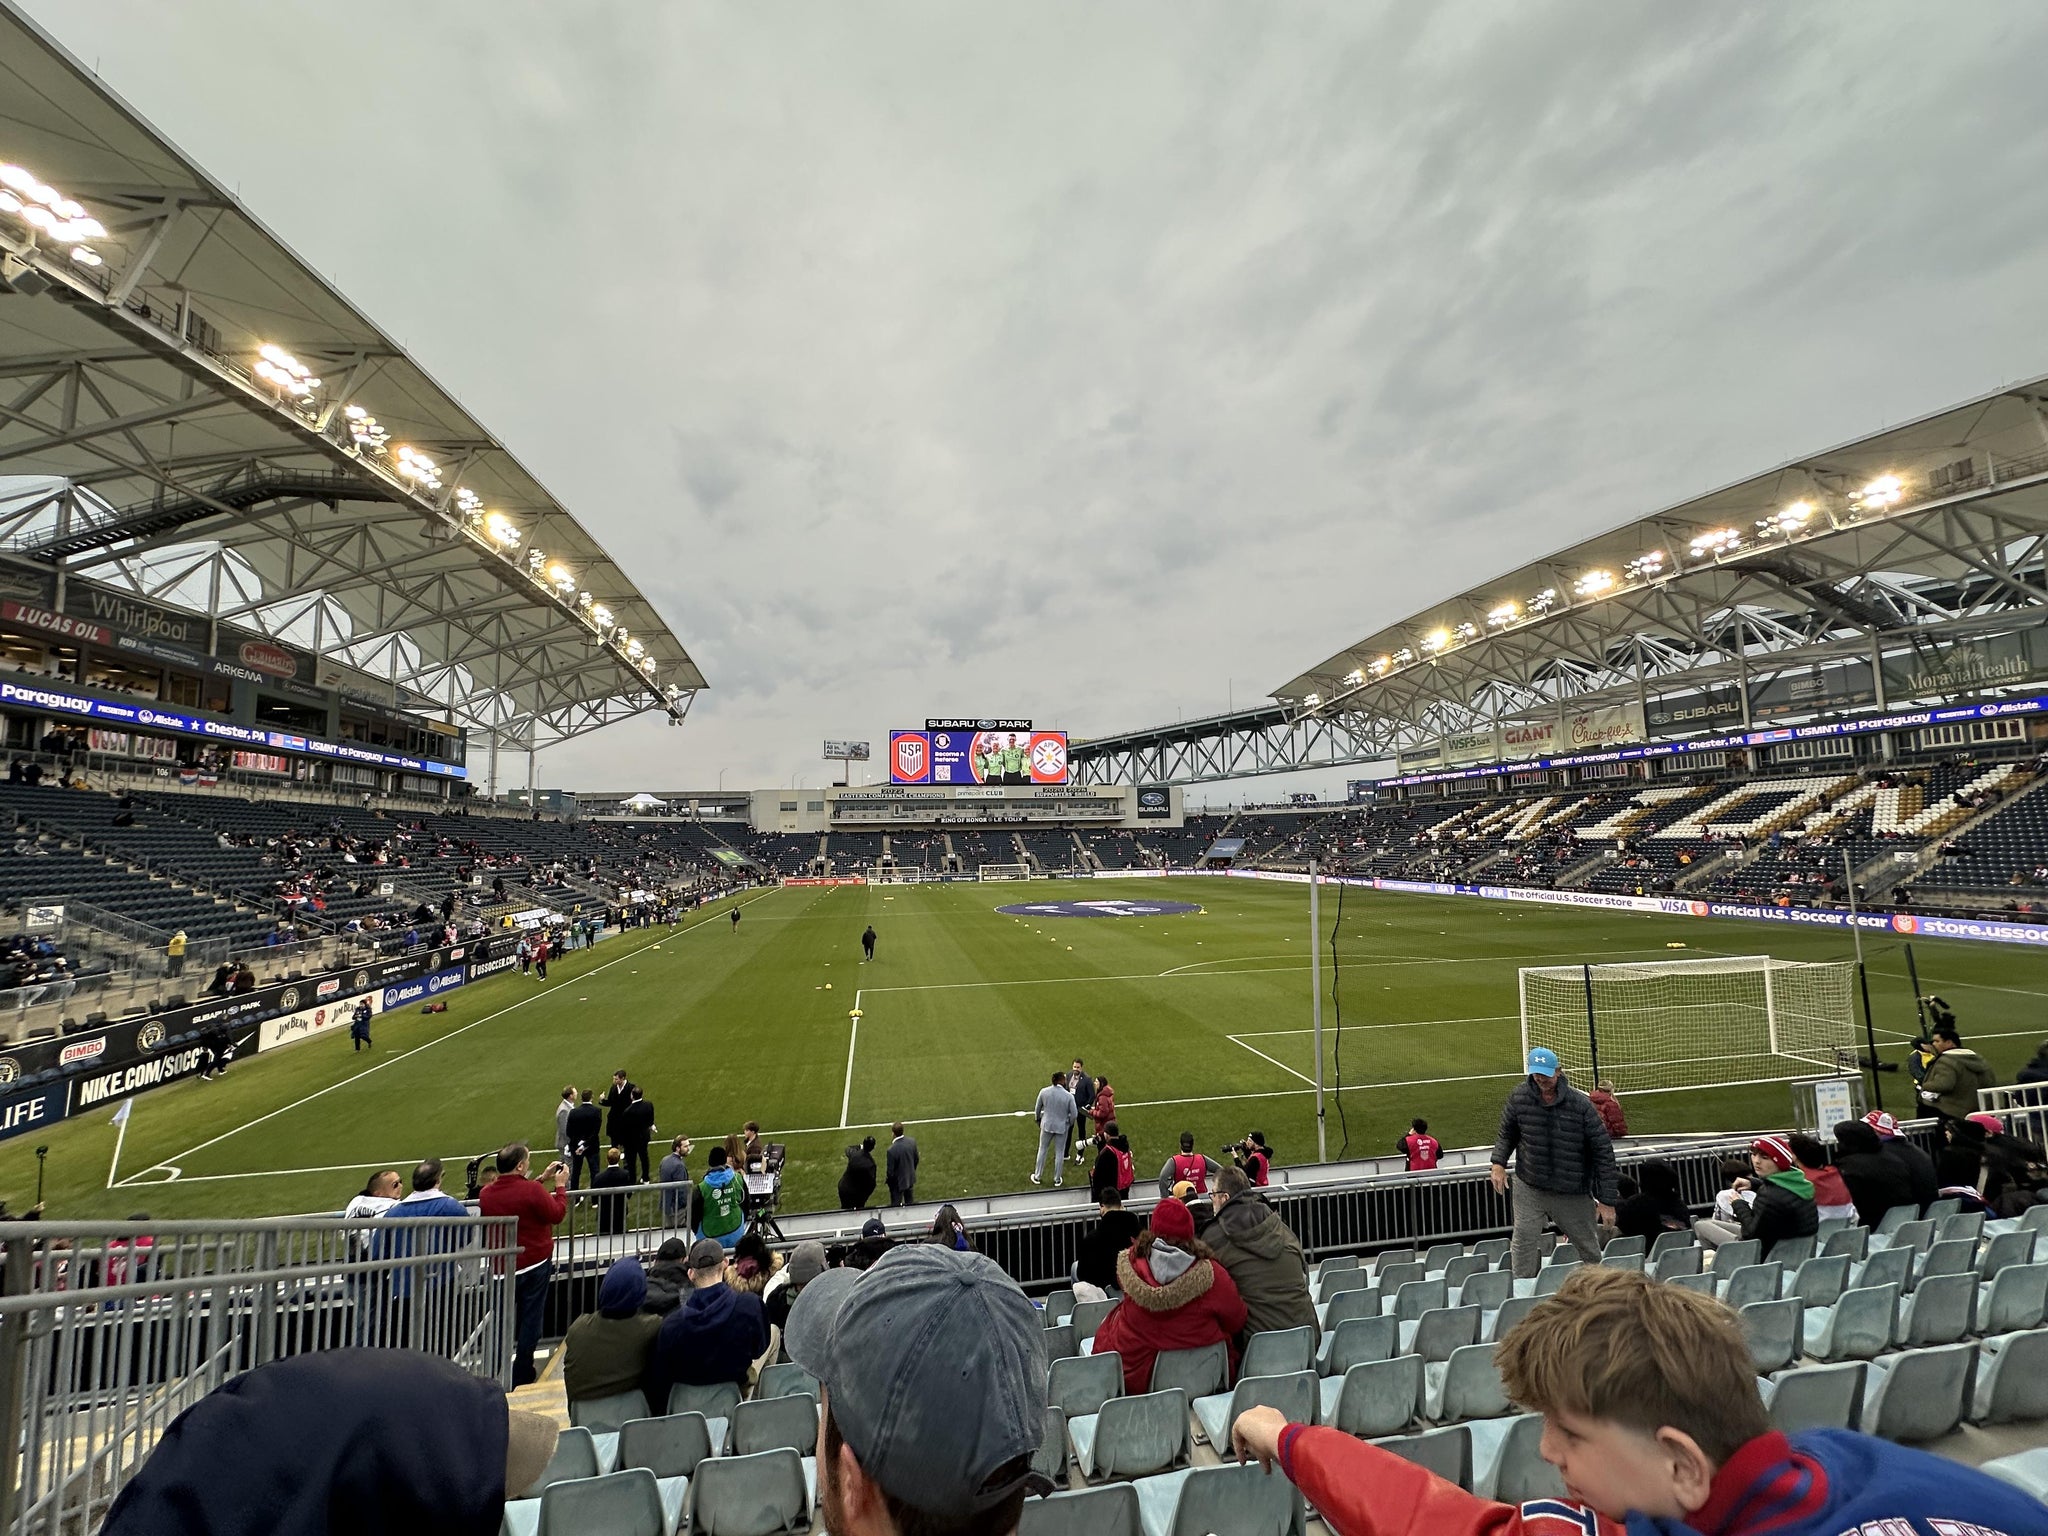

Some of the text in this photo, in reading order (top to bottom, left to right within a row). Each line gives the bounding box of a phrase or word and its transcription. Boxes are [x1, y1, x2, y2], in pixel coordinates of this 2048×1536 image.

[16, 606, 101, 642] LUCAS OIL
[91, 591, 189, 642] Whirlpool
[213, 662, 264, 684] ARKEMA
[1790, 679, 1825, 691] BIMBO
[1, 683, 94, 713] Paraguay
[152, 714, 185, 728] Allstate
[1673, 701, 1740, 721] SUBARU
[927, 720, 1030, 728] SUBARU PARK
[1795, 723, 1841, 737] USMNT
[1841, 722, 1858, 731] vs
[1858, 711, 1932, 733] Paraguay
[1998, 701, 2041, 714] Allstate
[204, 722, 266, 742] Chester, PA
[1504, 724, 1553, 744] GIANT
[1571, 719, 1635, 744] Chick-fil-A
[307, 741, 339, 755] USMNT
[347, 748, 384, 763] Paraguay
[900, 743, 921, 757] USA
[1448, 736, 1491, 750] WSFS bank
[1687, 736, 1744, 750] Chester, PA
[1583, 752, 1621, 763] Paraguay
[156, 768, 169, 777] 106
[1435, 885, 1449, 893] USA
[1487, 888, 1504, 896] PAR
[1510, 890, 1689, 912] The Official U.S. Soccer Store VISA
[1711, 904, 1889, 928] Official U.S. Soccer Gear
[477, 955, 517, 976] USSOCCER.COM
[439, 973, 462, 988] Allstate
[396, 985, 424, 1001] Allstate
[240, 1000, 262, 1012] PARK
[343, 1001, 357, 1013] BEA
[276, 1016, 309, 1041] JIM BEAM
[64, 1042, 103, 1060] BIMBO
[80, 1047, 202, 1106] NIKE.COM/SOCC
[0, 1096, 46, 1131] IFE
